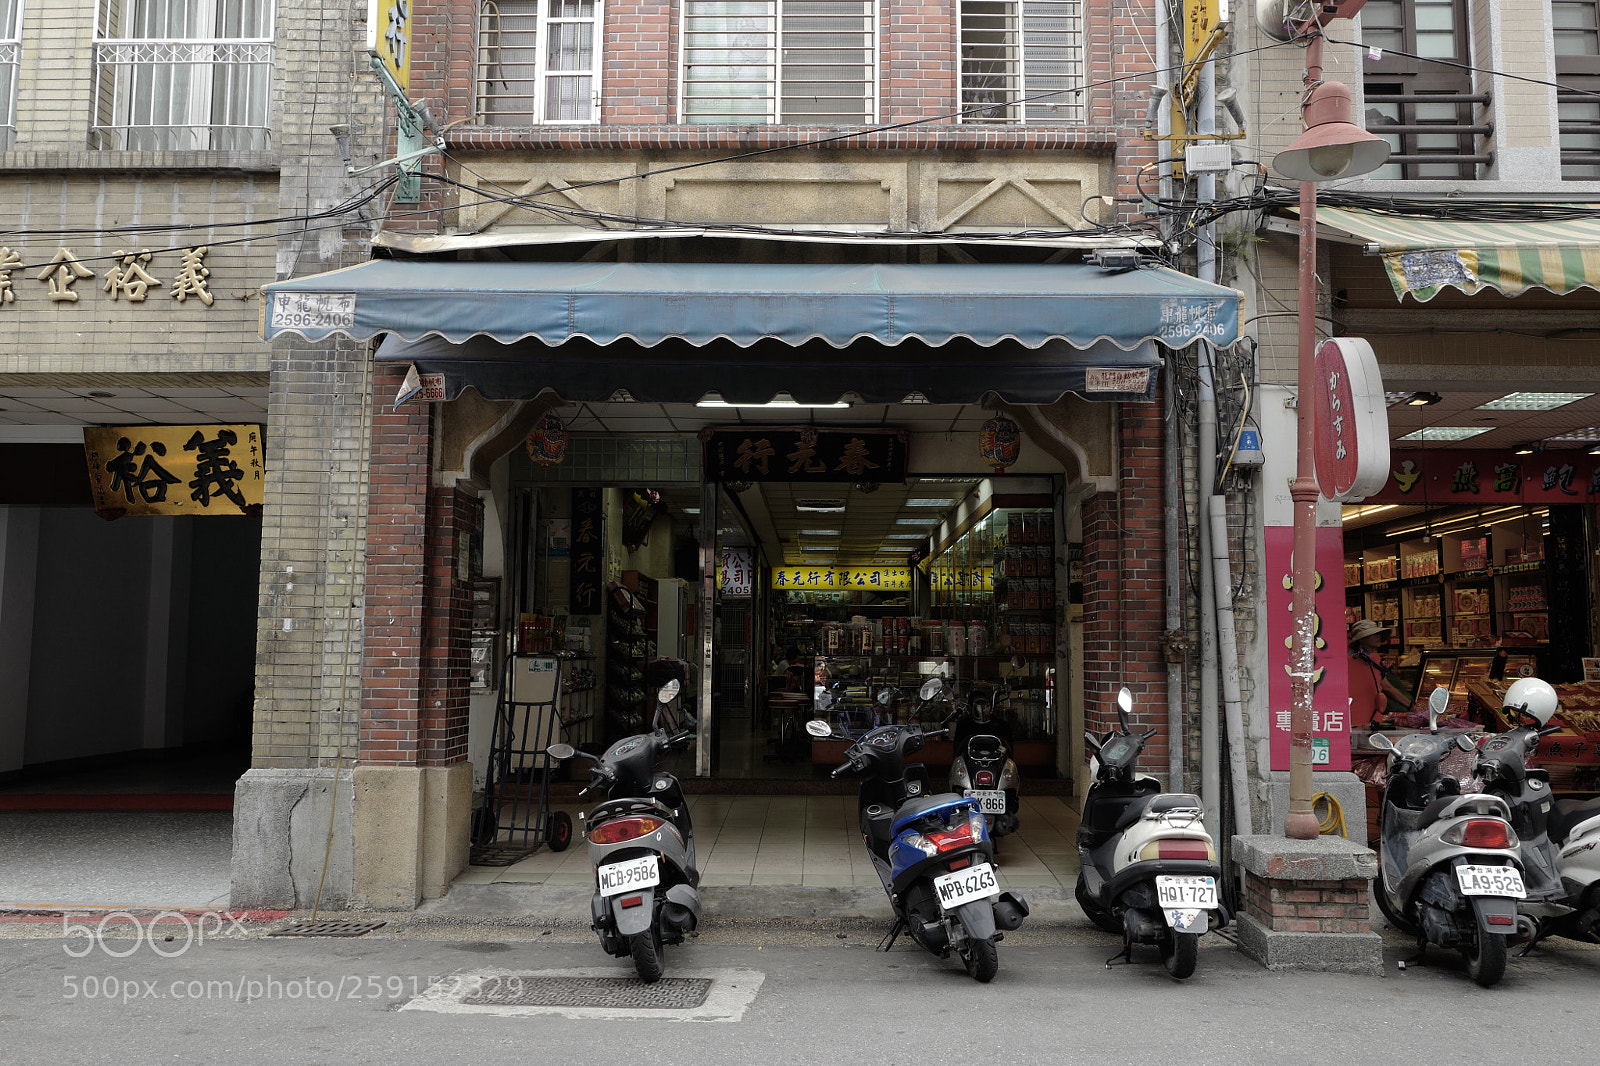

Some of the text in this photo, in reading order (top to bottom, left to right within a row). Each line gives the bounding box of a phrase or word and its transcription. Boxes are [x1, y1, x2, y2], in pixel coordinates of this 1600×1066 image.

[275, 313, 352, 327] 2596-2406
[1330, 371, 1347, 460] からすみ
[106, 430, 245, 507] 義裕
[1393, 459, 1420, 493] 子
[576, 517, 599, 608] 春元行
[775, 571, 881, 587] 春元行有限公司
[722, 586, 752, 595] 5405
